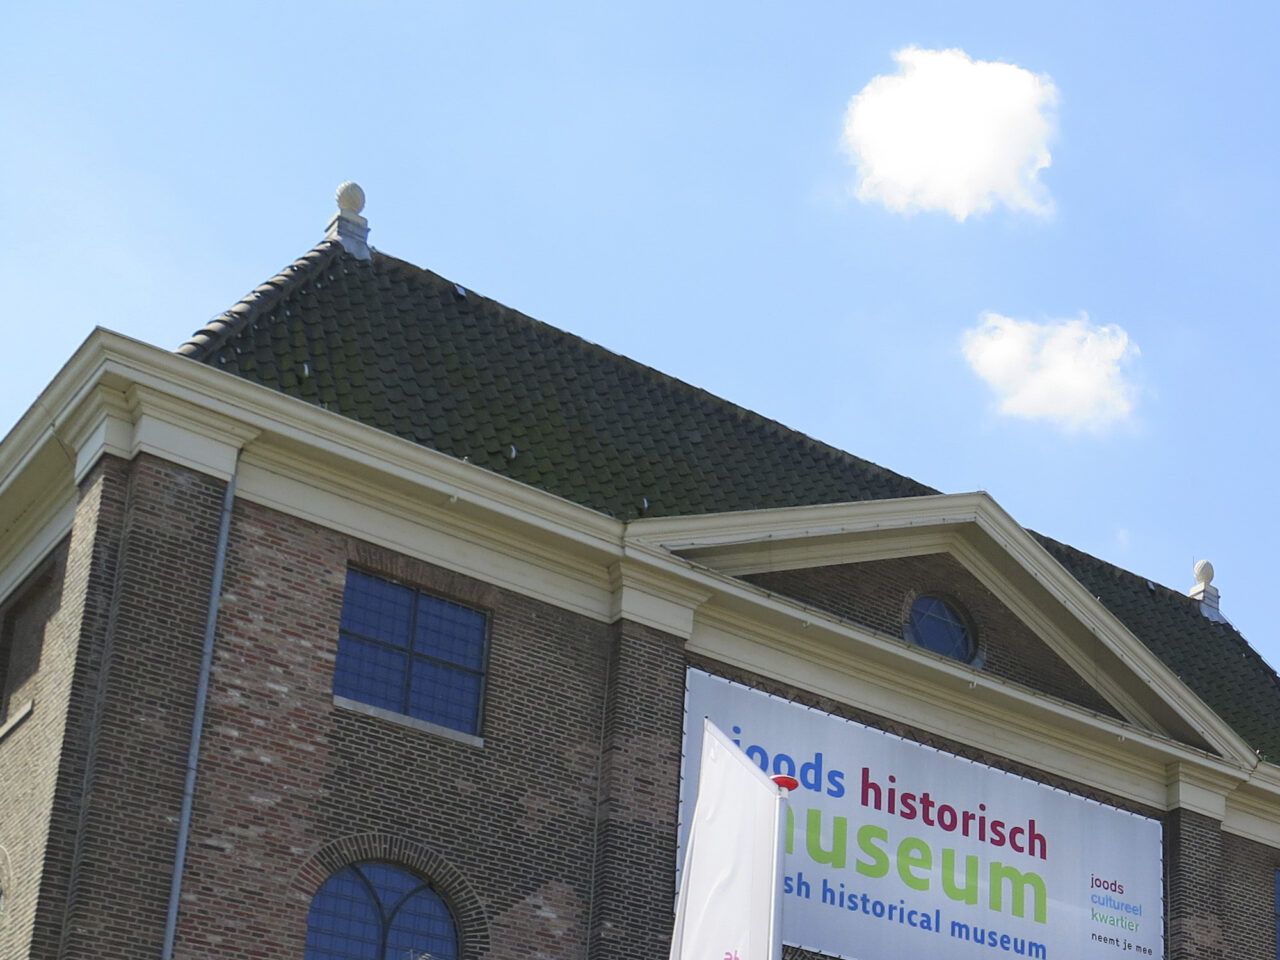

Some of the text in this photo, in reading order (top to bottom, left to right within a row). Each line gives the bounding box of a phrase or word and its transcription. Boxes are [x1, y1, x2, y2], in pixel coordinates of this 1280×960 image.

[860, 767, 1047, 861] historisch
[785, 803, 1047, 925] useum
[1091, 873, 1125, 895] joods
[1091, 893, 1143, 917] cultureel
[821, 878, 941, 933] historical
[950, 921, 1047, 960] museum
[1091, 907, 1140, 932] kwartier
[1091, 932, 1153, 956] neemt je mee
